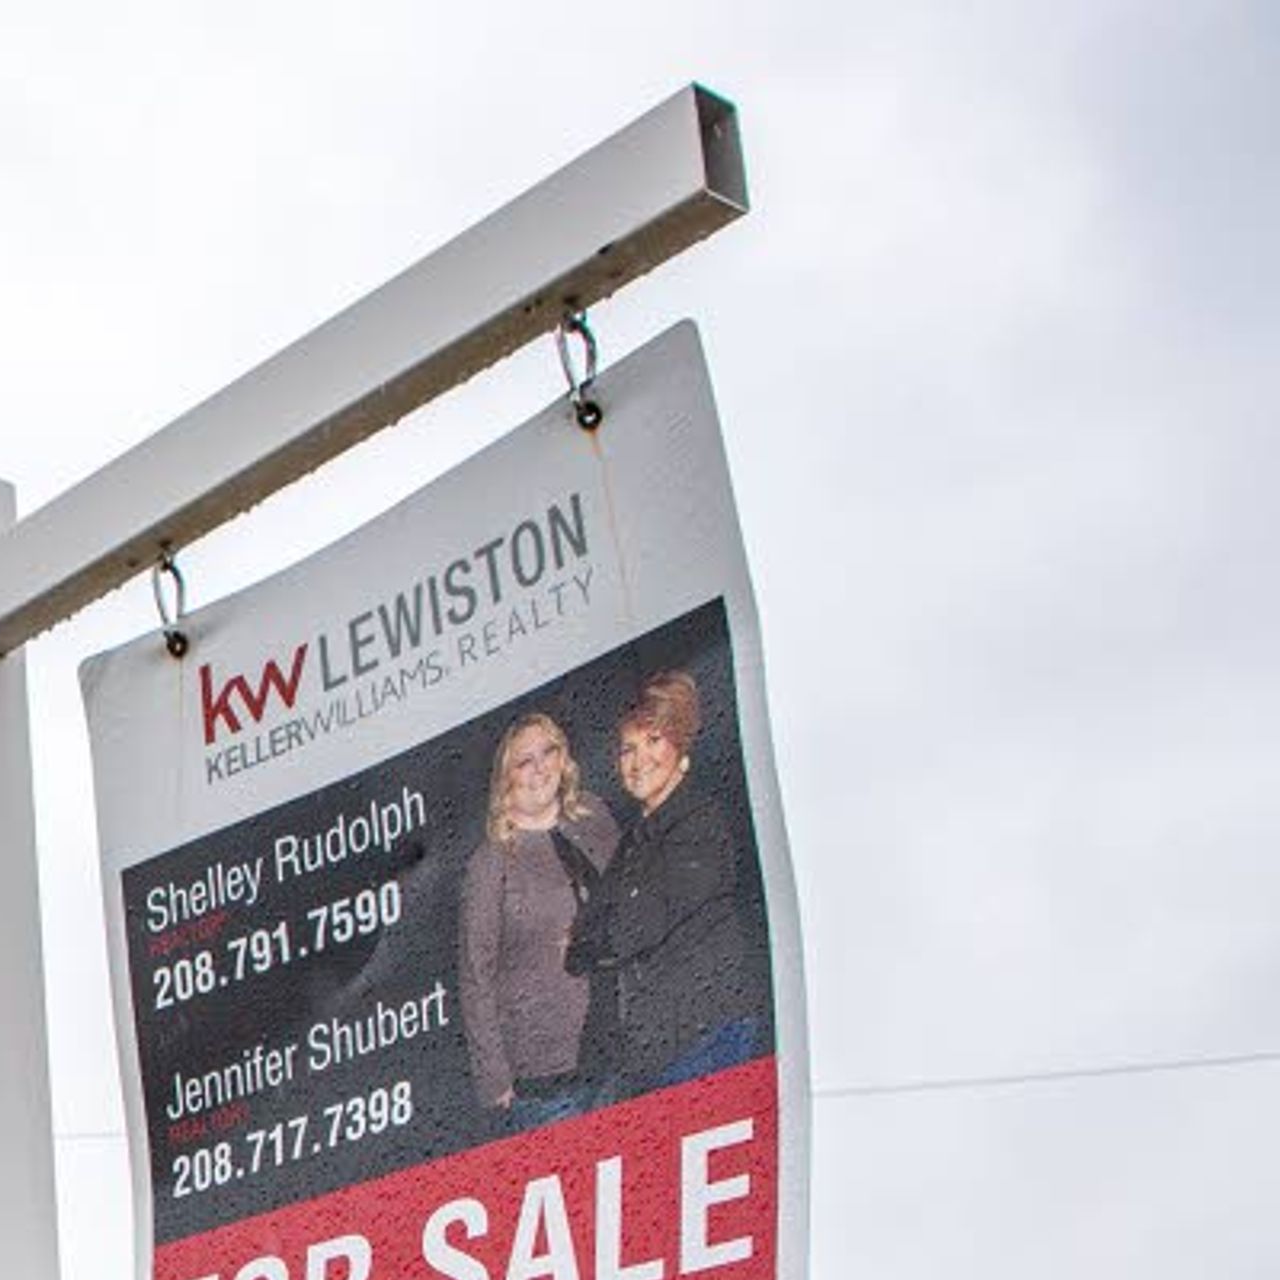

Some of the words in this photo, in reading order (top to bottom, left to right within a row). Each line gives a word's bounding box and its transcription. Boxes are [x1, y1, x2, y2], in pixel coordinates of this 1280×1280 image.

[200, 643, 308, 746] kw
[320, 493, 588, 692] LEWISTON
[458, 565, 593, 667] REALTY
[147, 856, 263, 932] Shelley
[275, 787, 425, 882] Rudolph
[153, 880, 402, 1010] 208.791.7590
[166, 1043, 298, 1119] Jennifer
[308, 981, 449, 1070] Shubert
[172, 1081, 412, 1198] 208.717.7398
